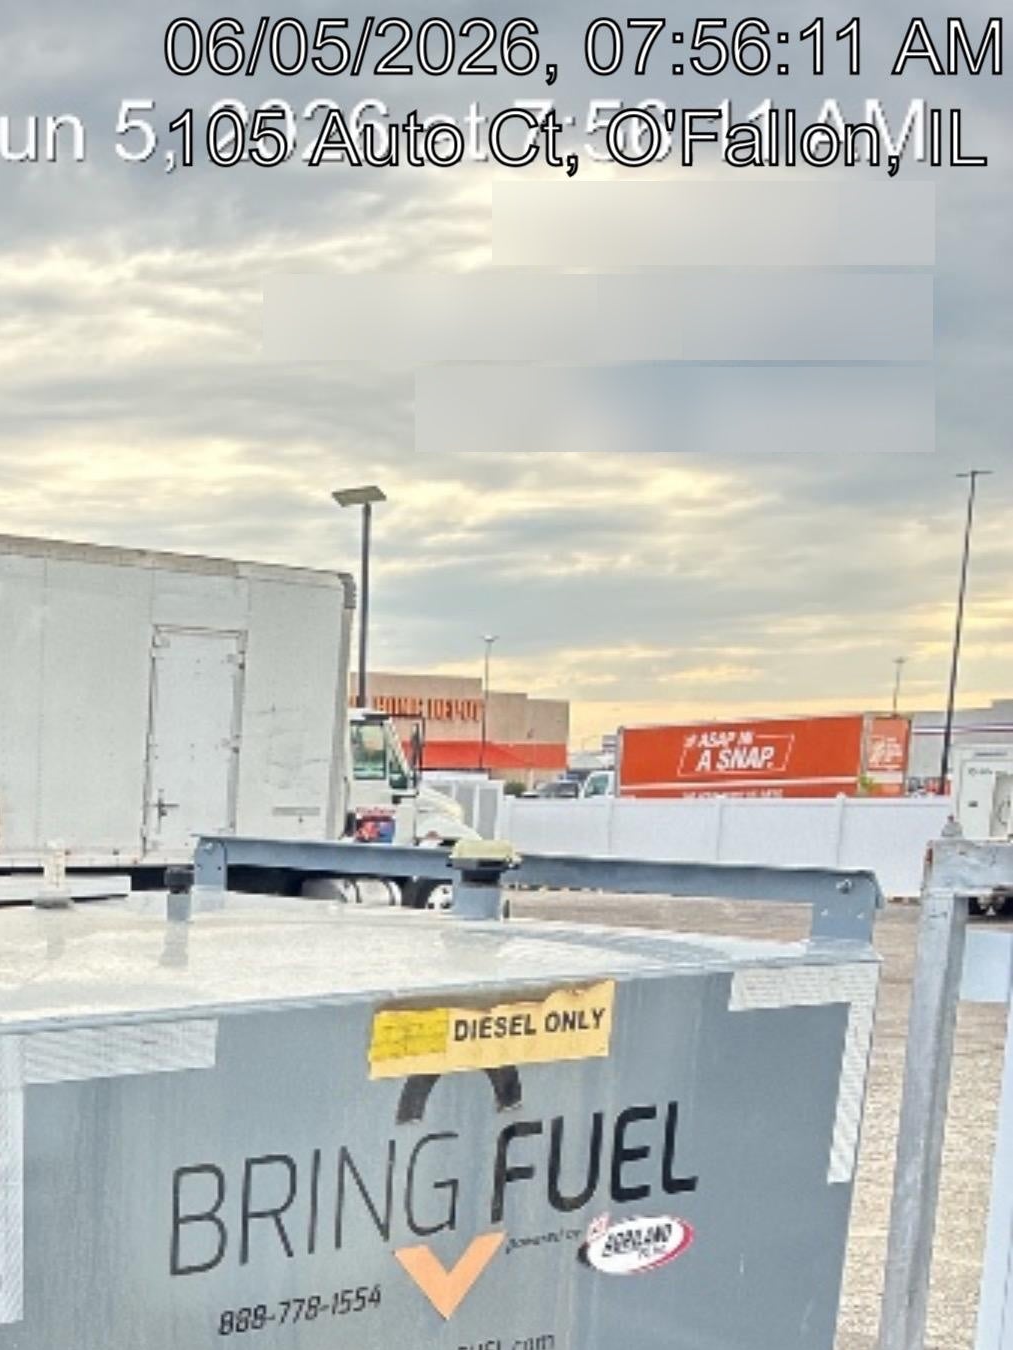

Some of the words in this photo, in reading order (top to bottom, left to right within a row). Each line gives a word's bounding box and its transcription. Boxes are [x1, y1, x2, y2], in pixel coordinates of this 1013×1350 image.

[694, 751, 712, 772] A
[453, 1013, 537, 1043] DIESEL
[543, 1007, 607, 1034] ONLY
[169, 1130, 459, 1276] BRING
[491, 1101, 698, 1225] FUEL
[217, 1283, 383, 1336] 888-778-1554
